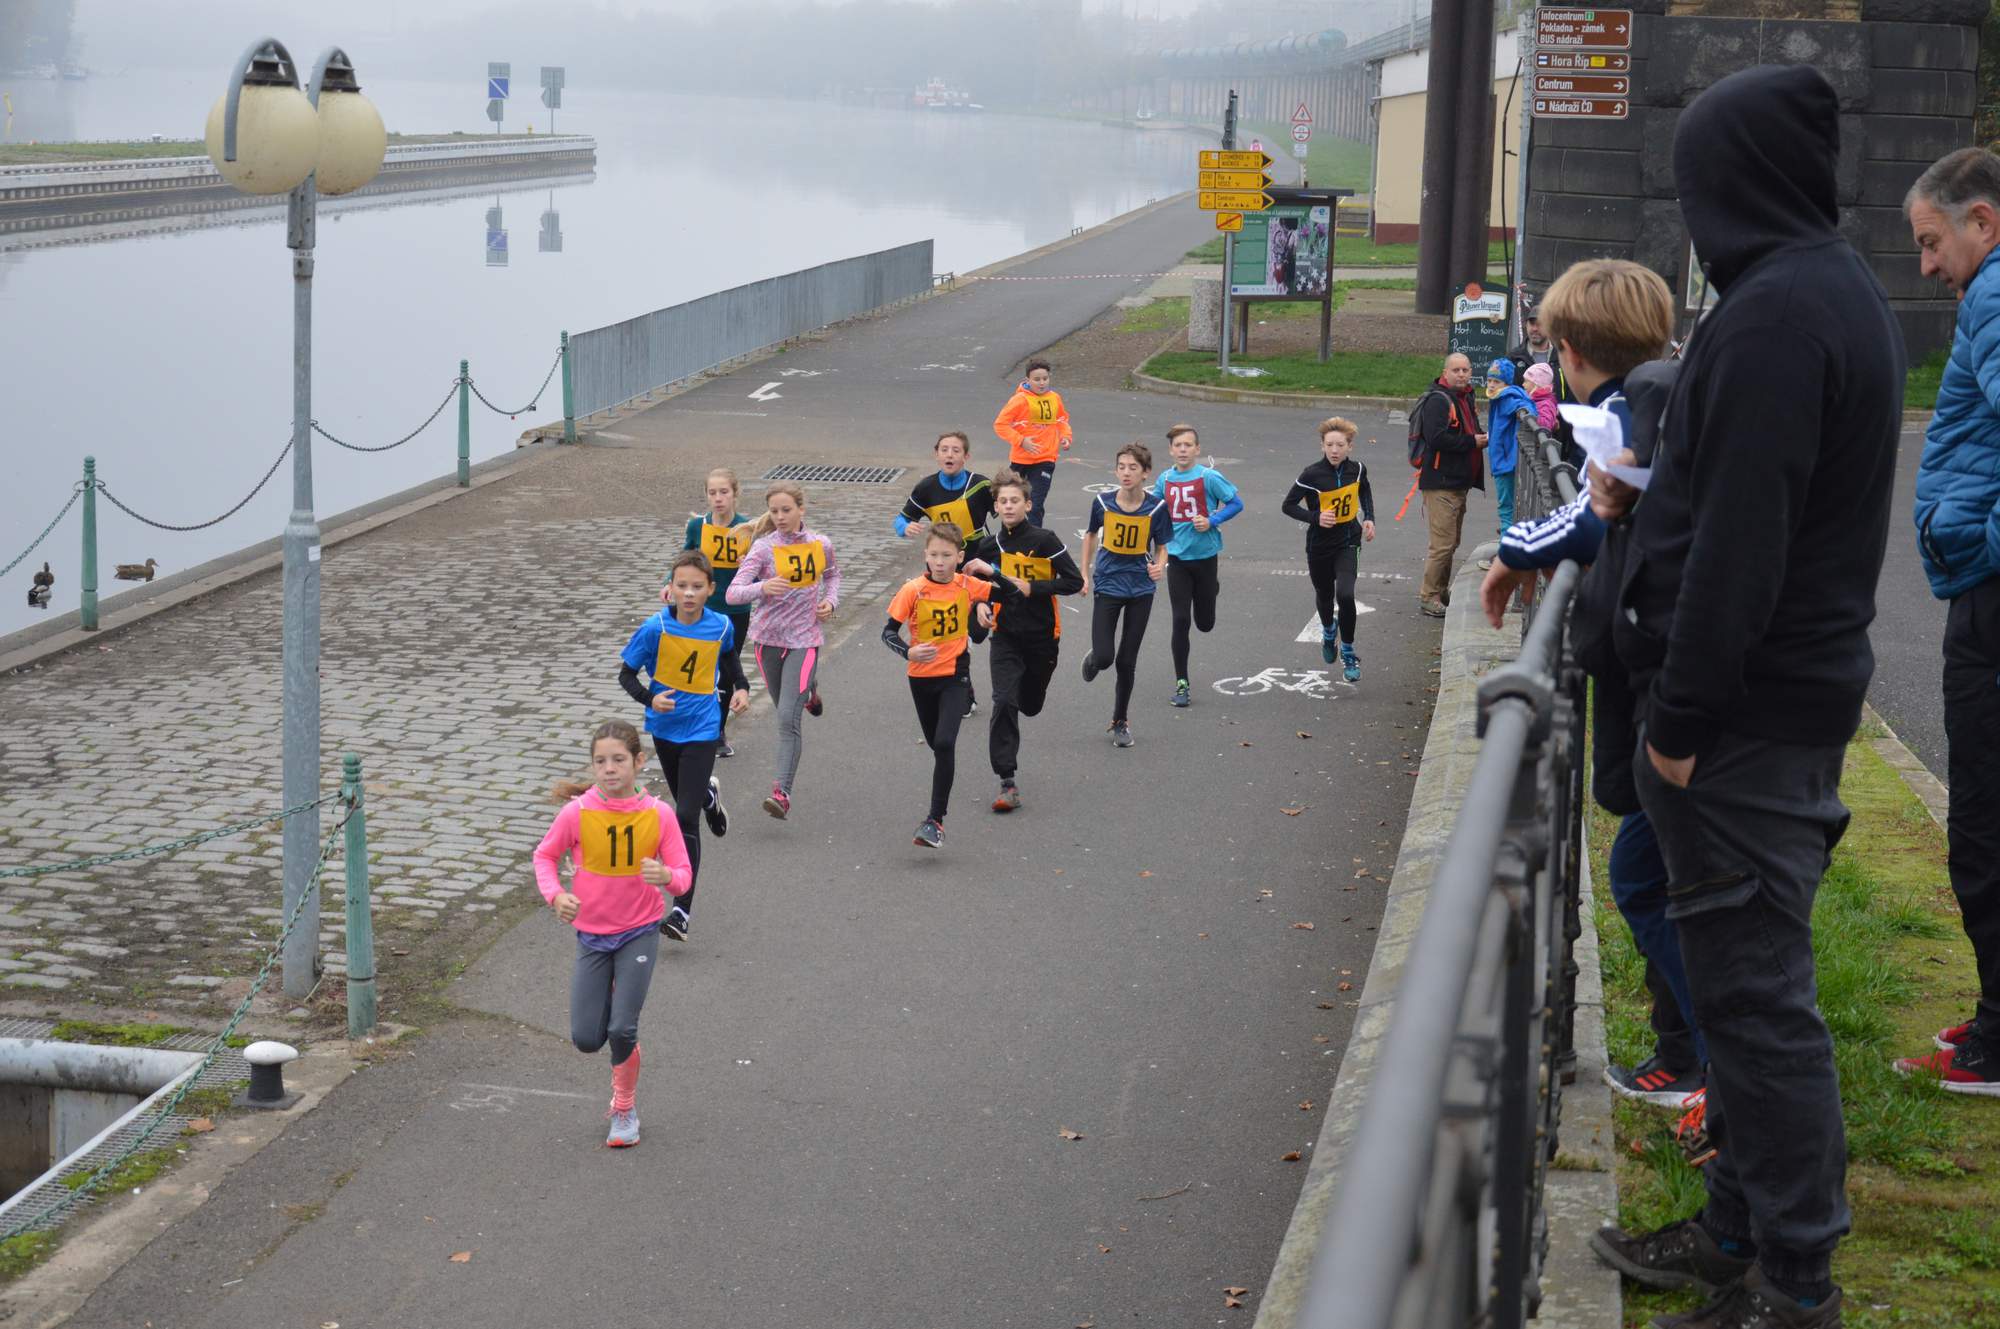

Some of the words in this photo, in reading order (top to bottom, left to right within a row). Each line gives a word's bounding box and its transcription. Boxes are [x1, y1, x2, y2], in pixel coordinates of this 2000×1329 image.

[1541, 11, 1584, 20] Infocentrum
[1540, 22, 1574, 32] Pokladna
[1581, 24, 1605, 33] zámek
[1540, 34, 1554, 44] BUS
[1556, 34, 1583, 44] nádraží
[1551, 55, 1572, 66] Hora
[1538, 78, 1573, 90] Centrum
[1549, 100, 1579, 113] Nádraží
[1038, 400, 1052, 420] 13
[1169, 485, 1198, 519] 25
[1113, 523, 1139, 549] 30
[713, 535, 738, 563] 26
[788, 553, 816, 583] 34
[1013, 563, 1036, 581] 15
[932, 603, 959, 637] 33
[680, 650, 699, 684] 4
[607, 824, 634, 867] 11
